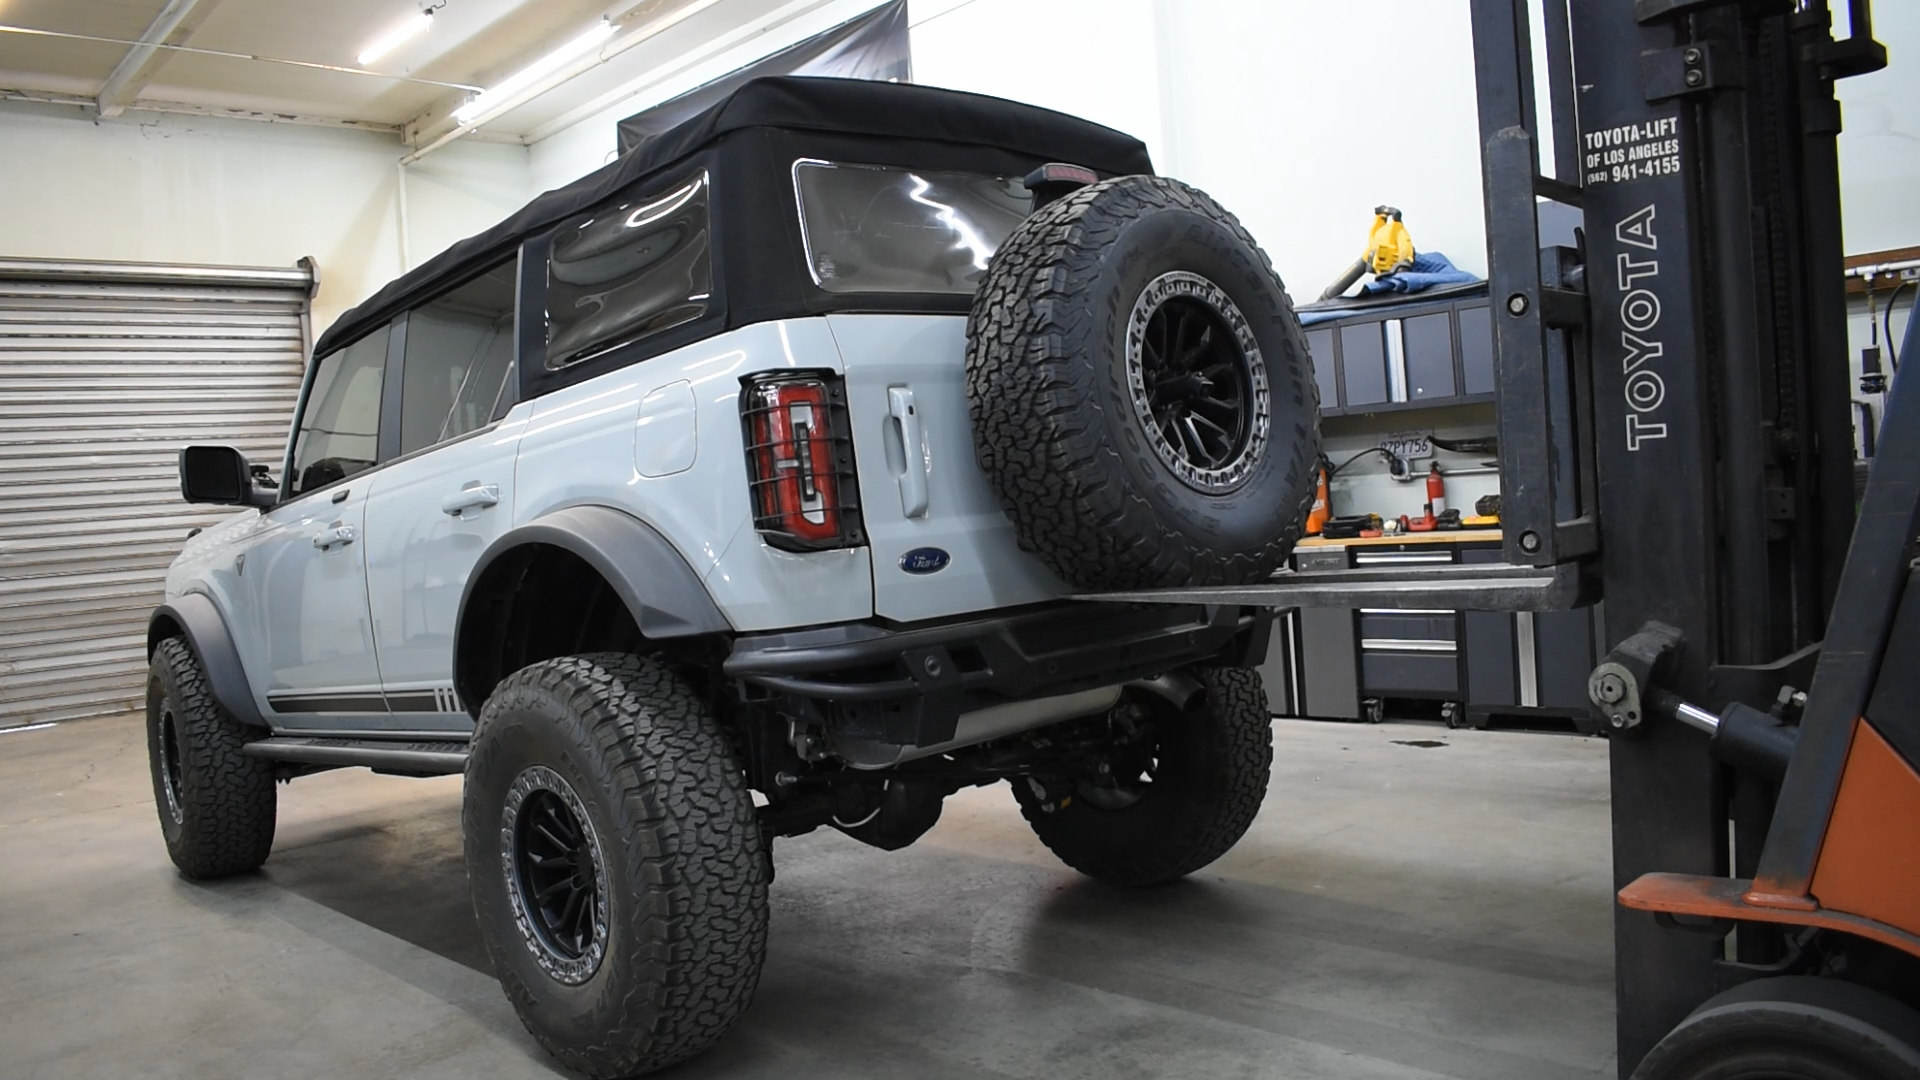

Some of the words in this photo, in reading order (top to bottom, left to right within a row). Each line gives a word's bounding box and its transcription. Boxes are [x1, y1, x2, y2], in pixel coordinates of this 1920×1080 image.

[1585, 117, 1677, 150] TOYOTA-LIFT
[1586, 153, 1601, 169] OF
[1604, 148, 1625, 166] LOS
[1628, 139, 1679, 161] ANGELES
[1587, 171, 1608, 185] (562)
[1612, 156, 1680, 183] 941-4155
[1615, 204, 1667, 451] TOYOTA
